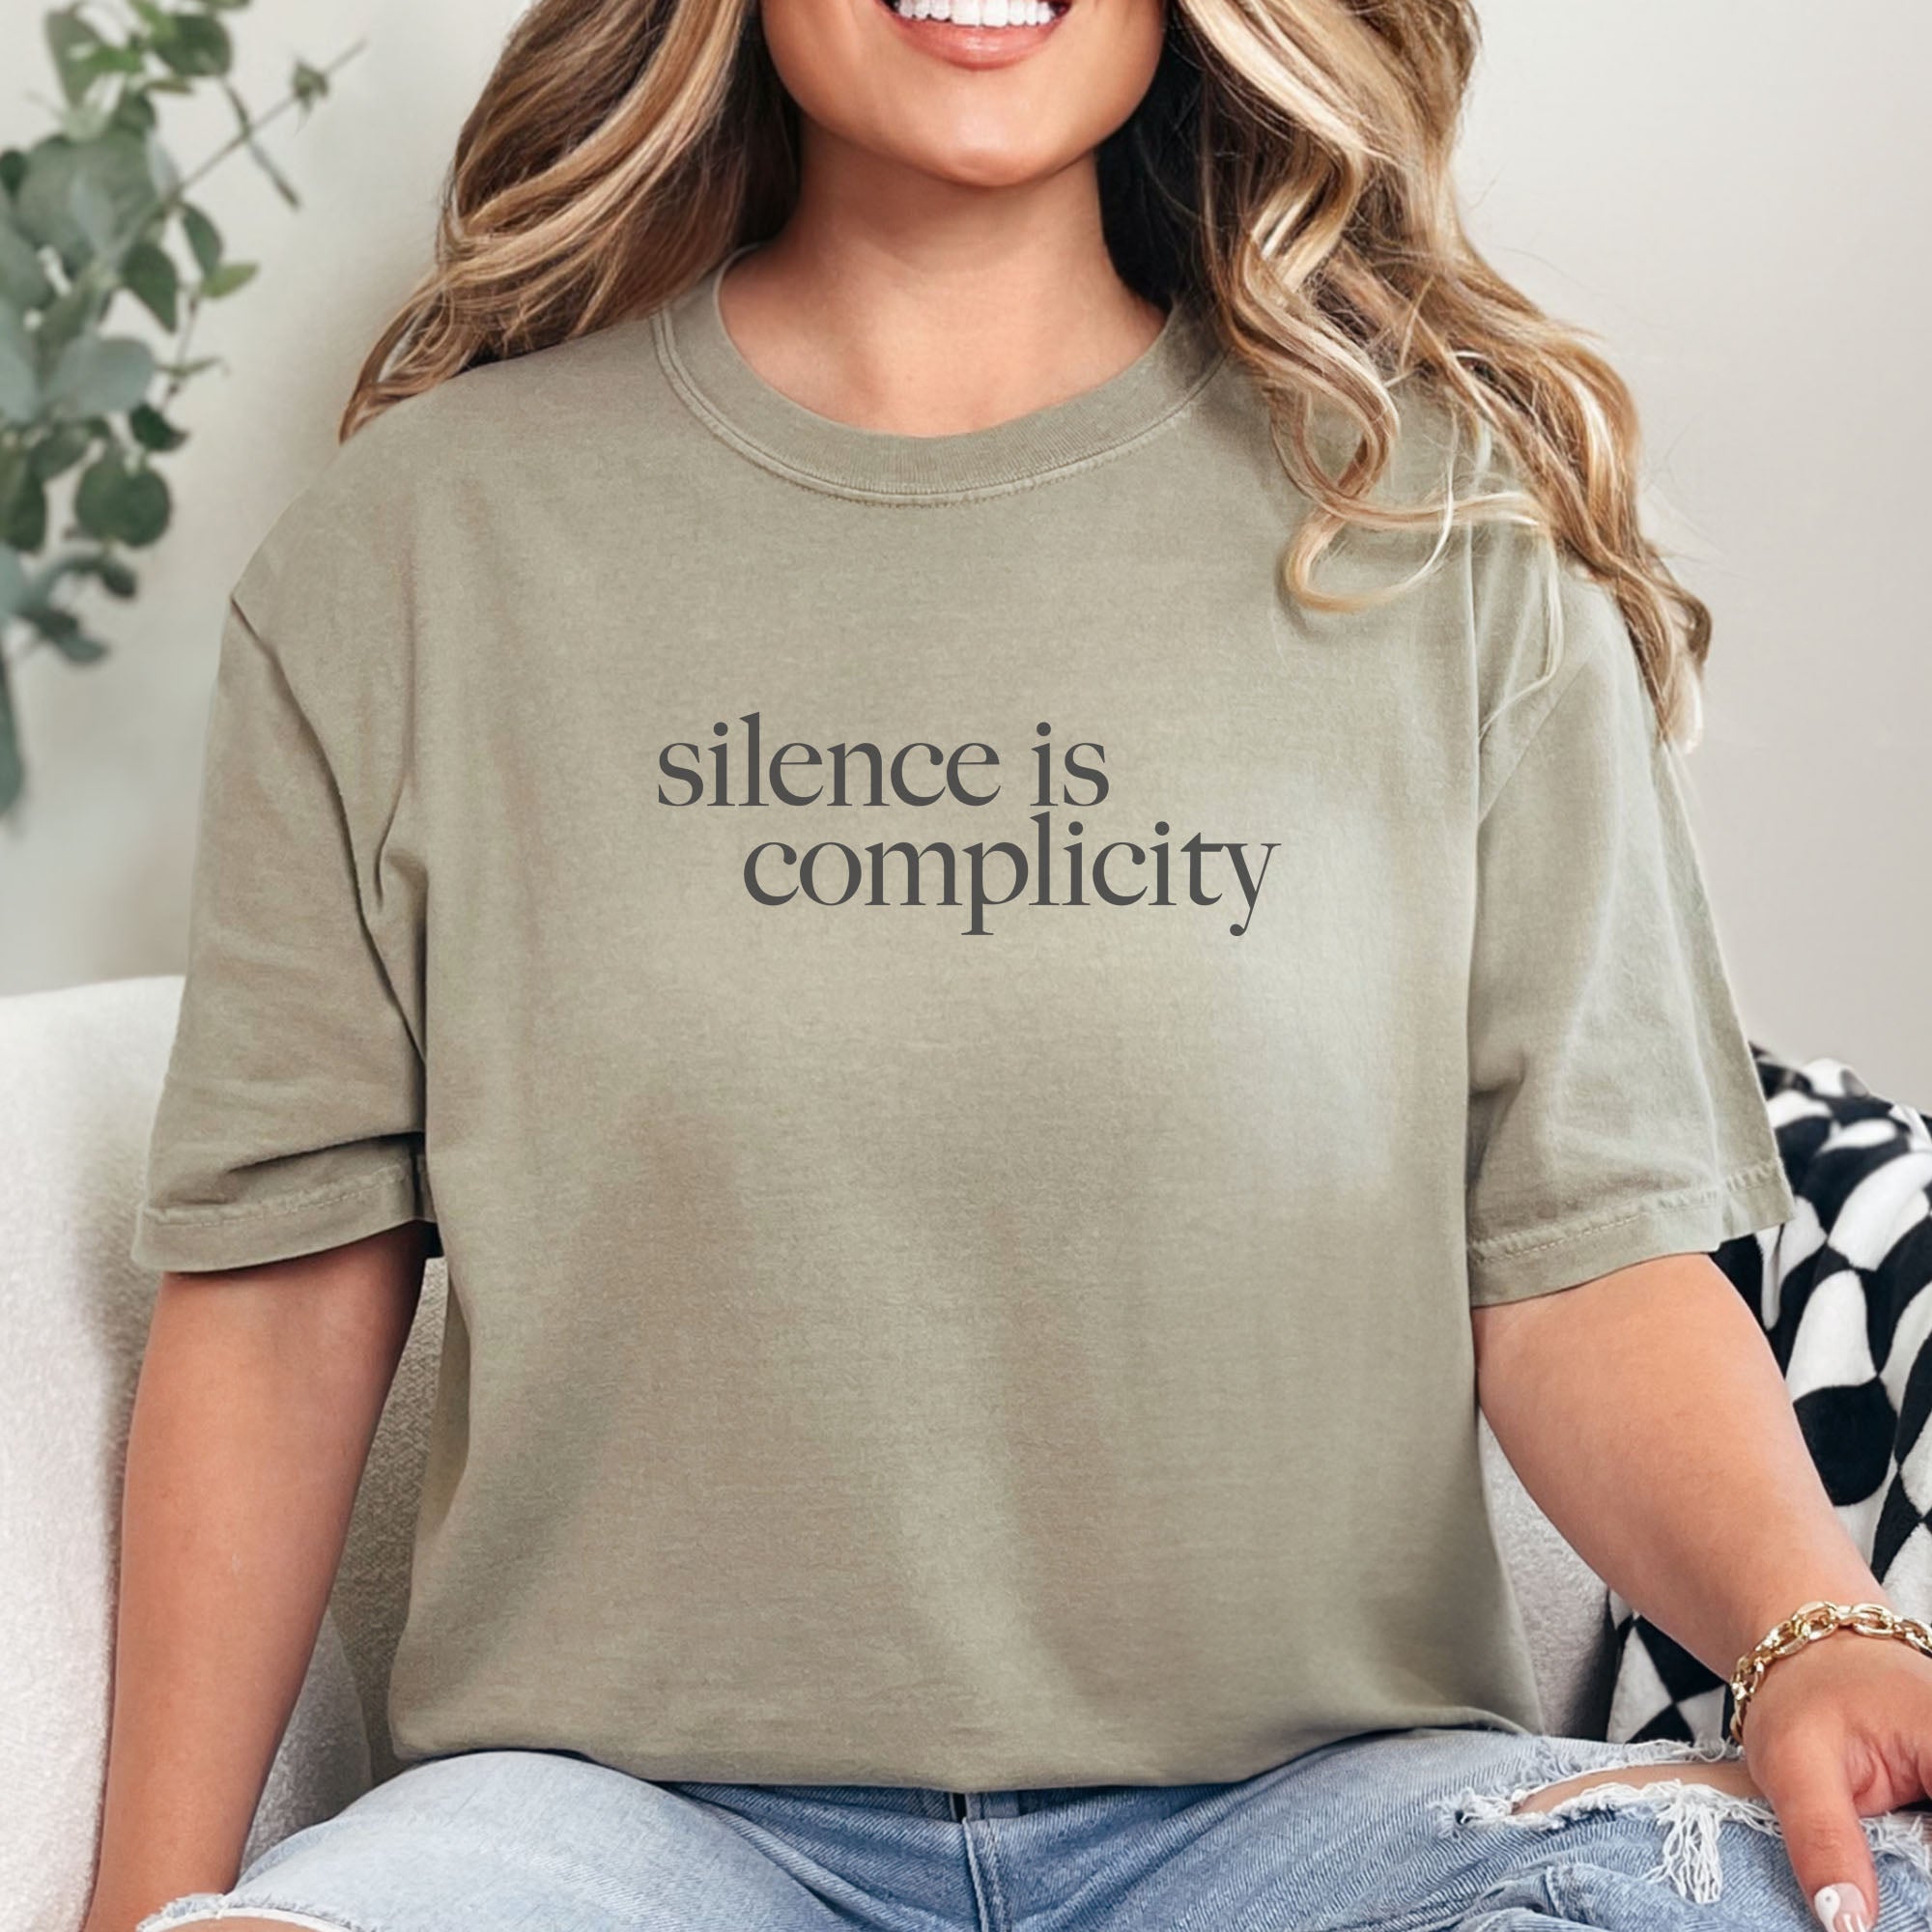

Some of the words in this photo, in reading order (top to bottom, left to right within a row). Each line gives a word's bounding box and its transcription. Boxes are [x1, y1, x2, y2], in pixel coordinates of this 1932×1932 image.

[658, 711, 1002, 807] silence
[1030, 722, 1110, 807] is
[743, 810, 1282, 937] complicity
